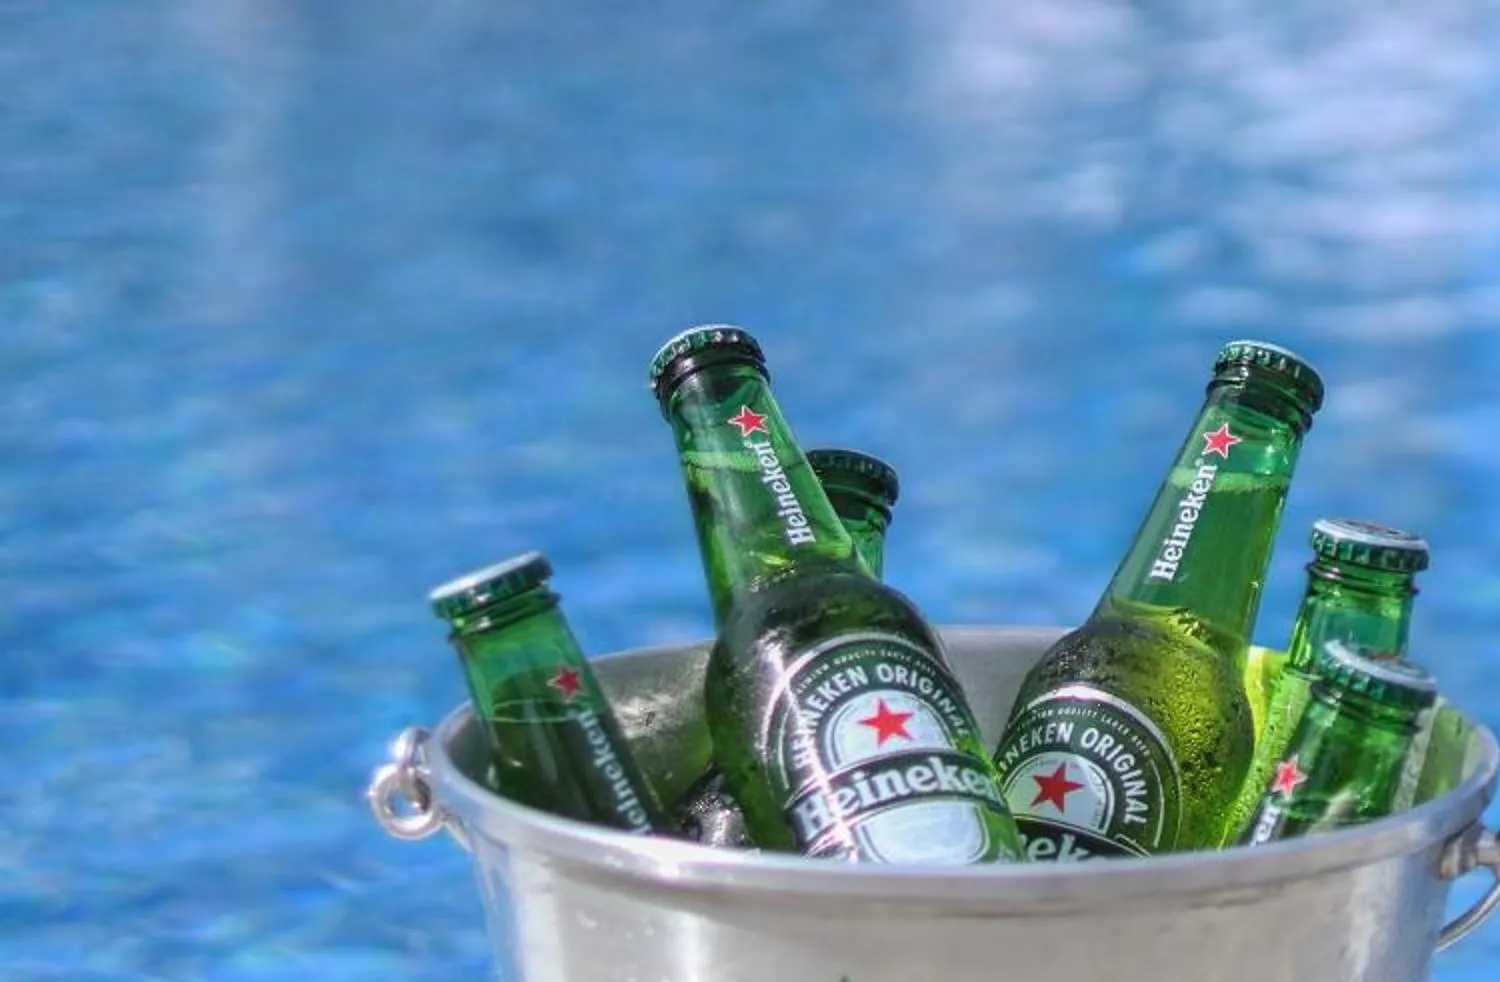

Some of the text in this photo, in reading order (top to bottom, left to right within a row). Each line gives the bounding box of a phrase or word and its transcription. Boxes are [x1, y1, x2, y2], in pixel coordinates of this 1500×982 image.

[753, 440, 816, 545] Heineken
[1149, 464, 1218, 581] Heineken
[578, 709, 653, 835] eineken
[999, 721, 1148, 824] INEKEN ORIGINAL
